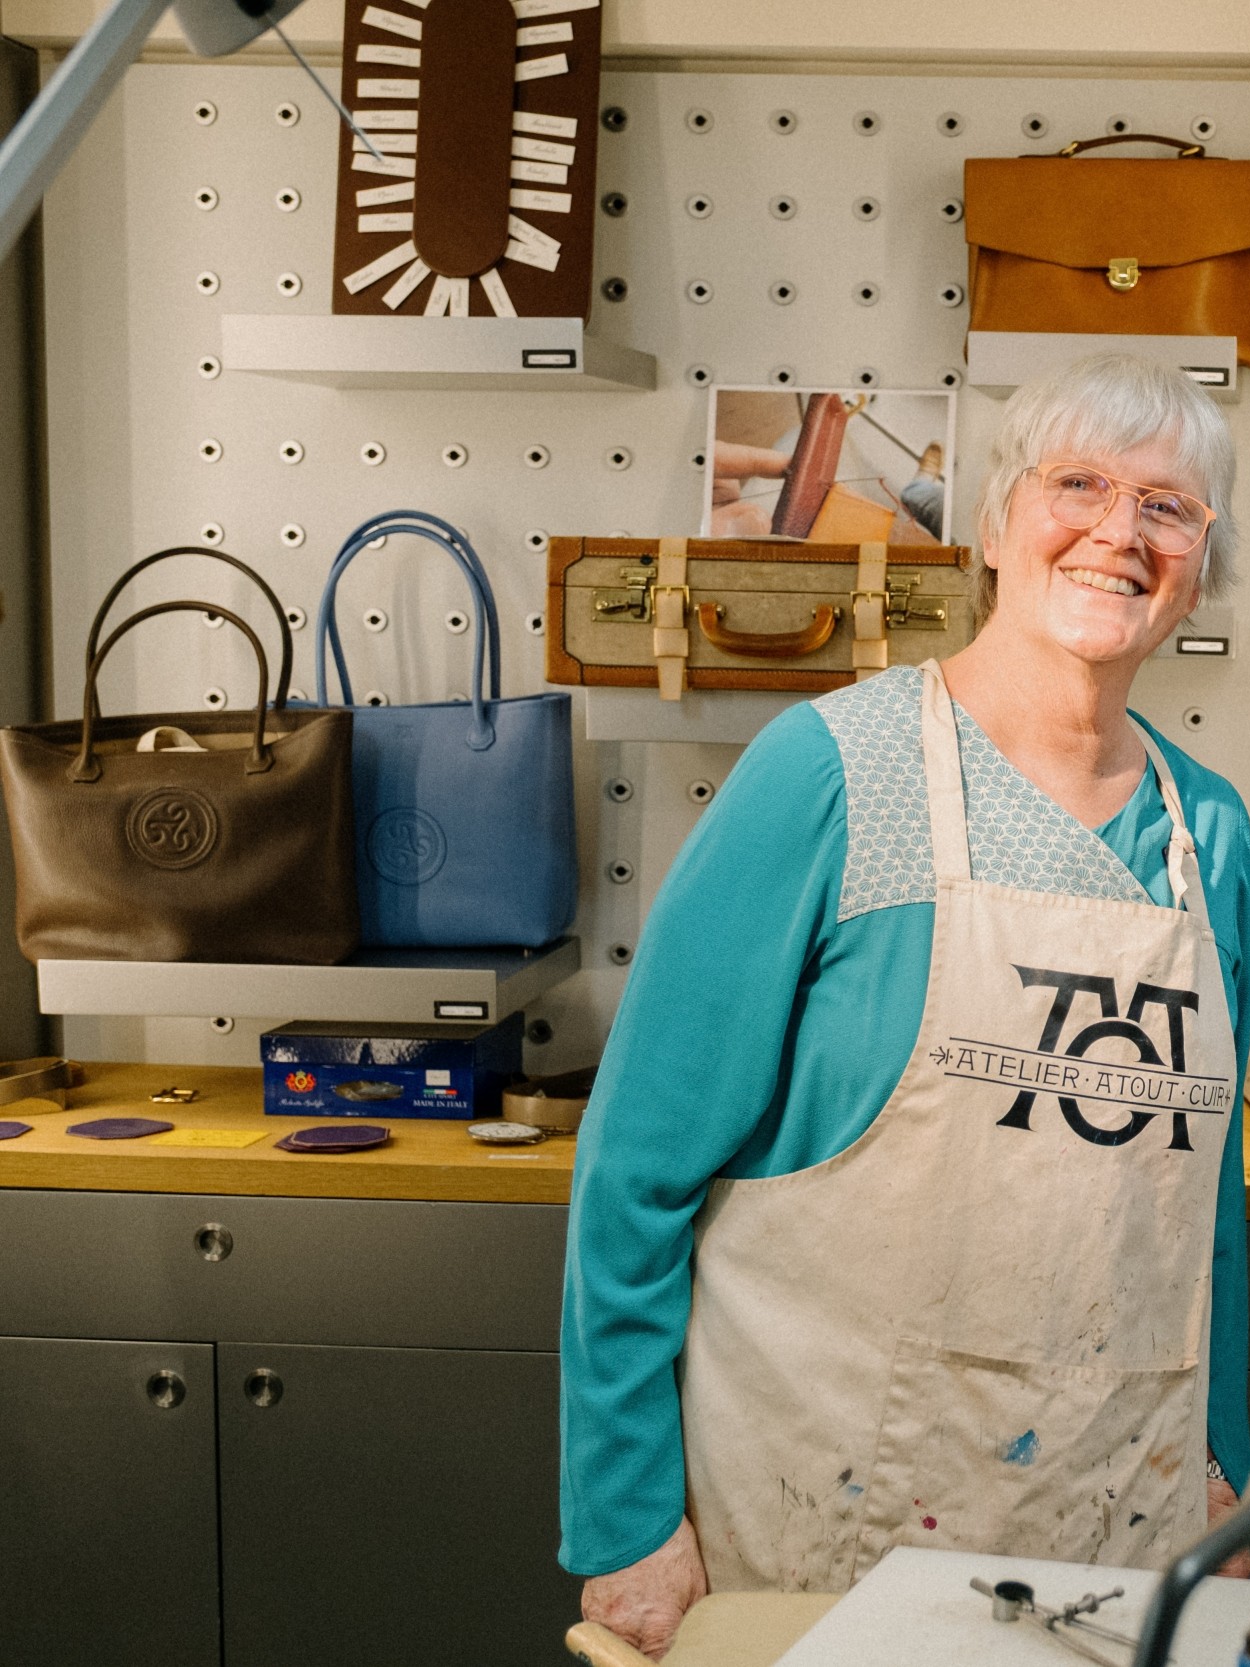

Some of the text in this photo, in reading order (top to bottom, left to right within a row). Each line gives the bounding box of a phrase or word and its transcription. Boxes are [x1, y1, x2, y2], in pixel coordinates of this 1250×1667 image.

[956, 1047, 1225, 1108] ATELIER ATOUT CUIR
